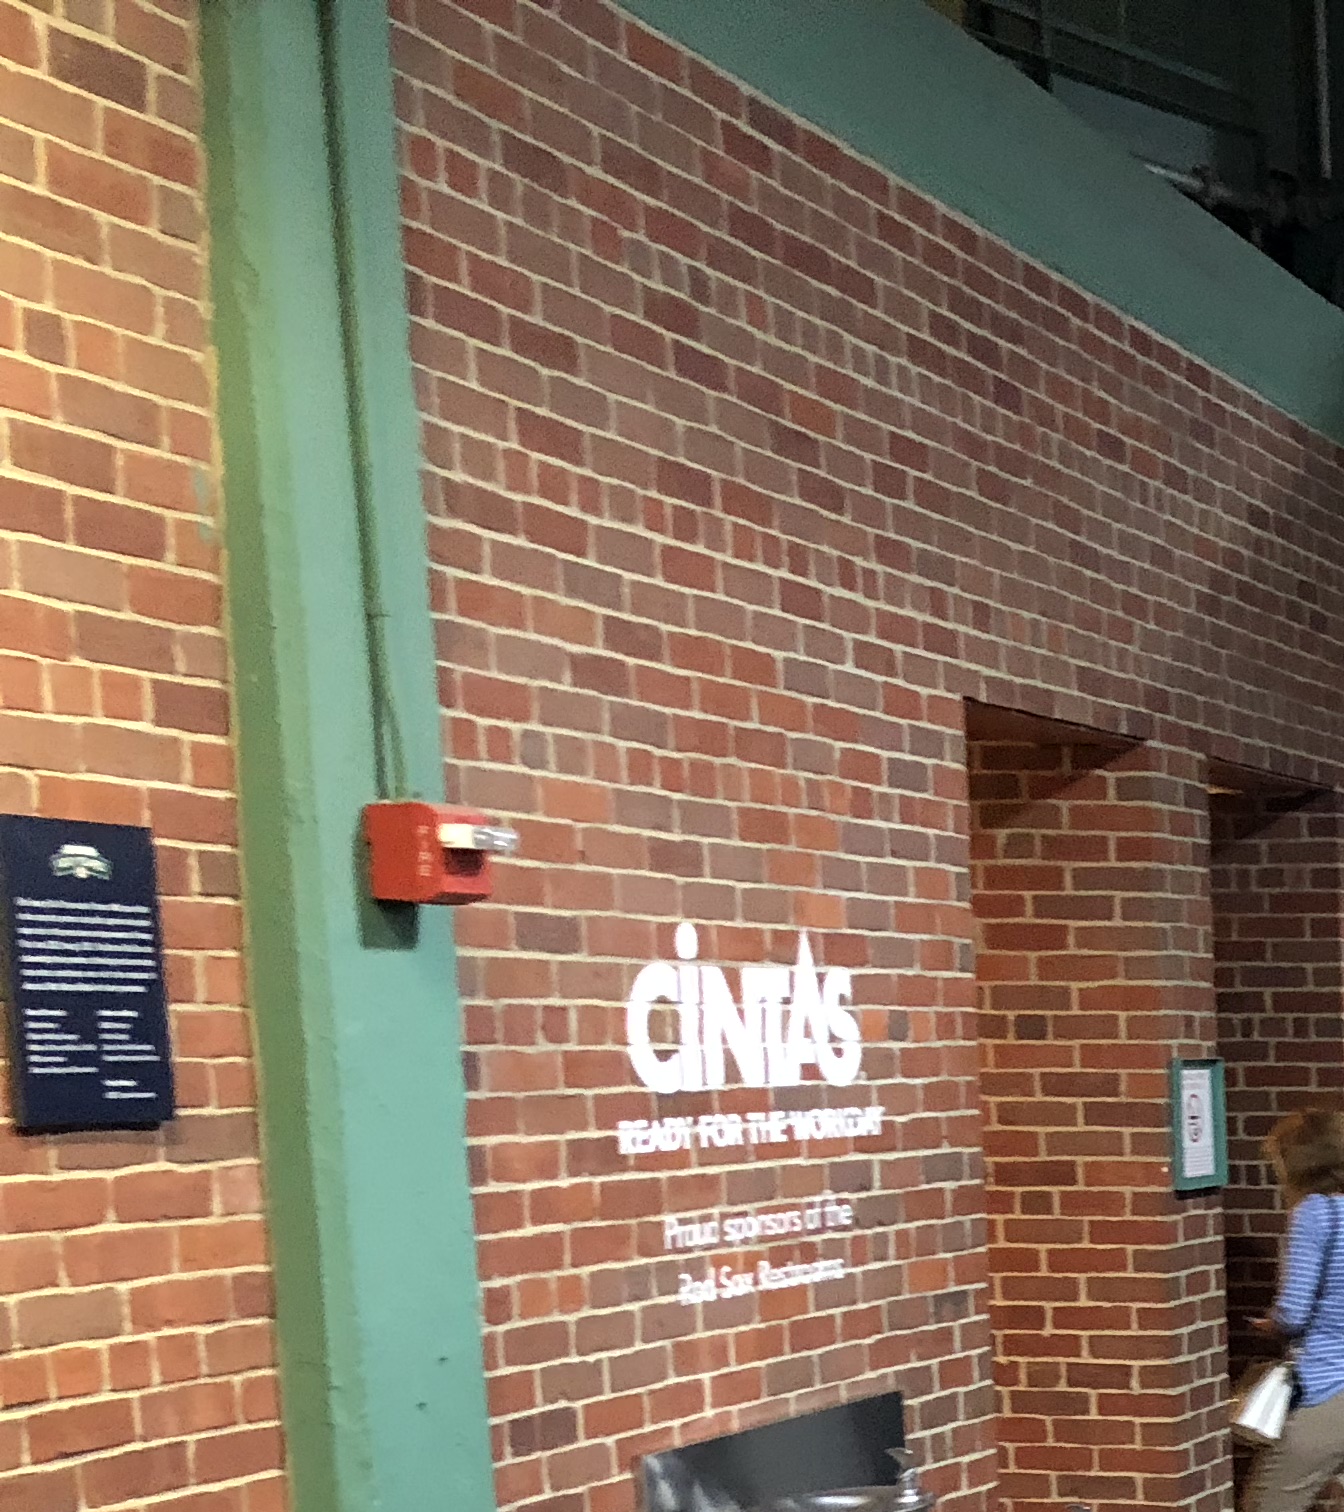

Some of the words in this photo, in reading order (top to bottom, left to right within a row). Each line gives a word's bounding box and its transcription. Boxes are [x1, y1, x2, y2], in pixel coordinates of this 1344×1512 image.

[616, 1117, 694, 1155] READY
[698, 1113, 744, 1148] FOR
[745, 1110, 789, 1144] THE
